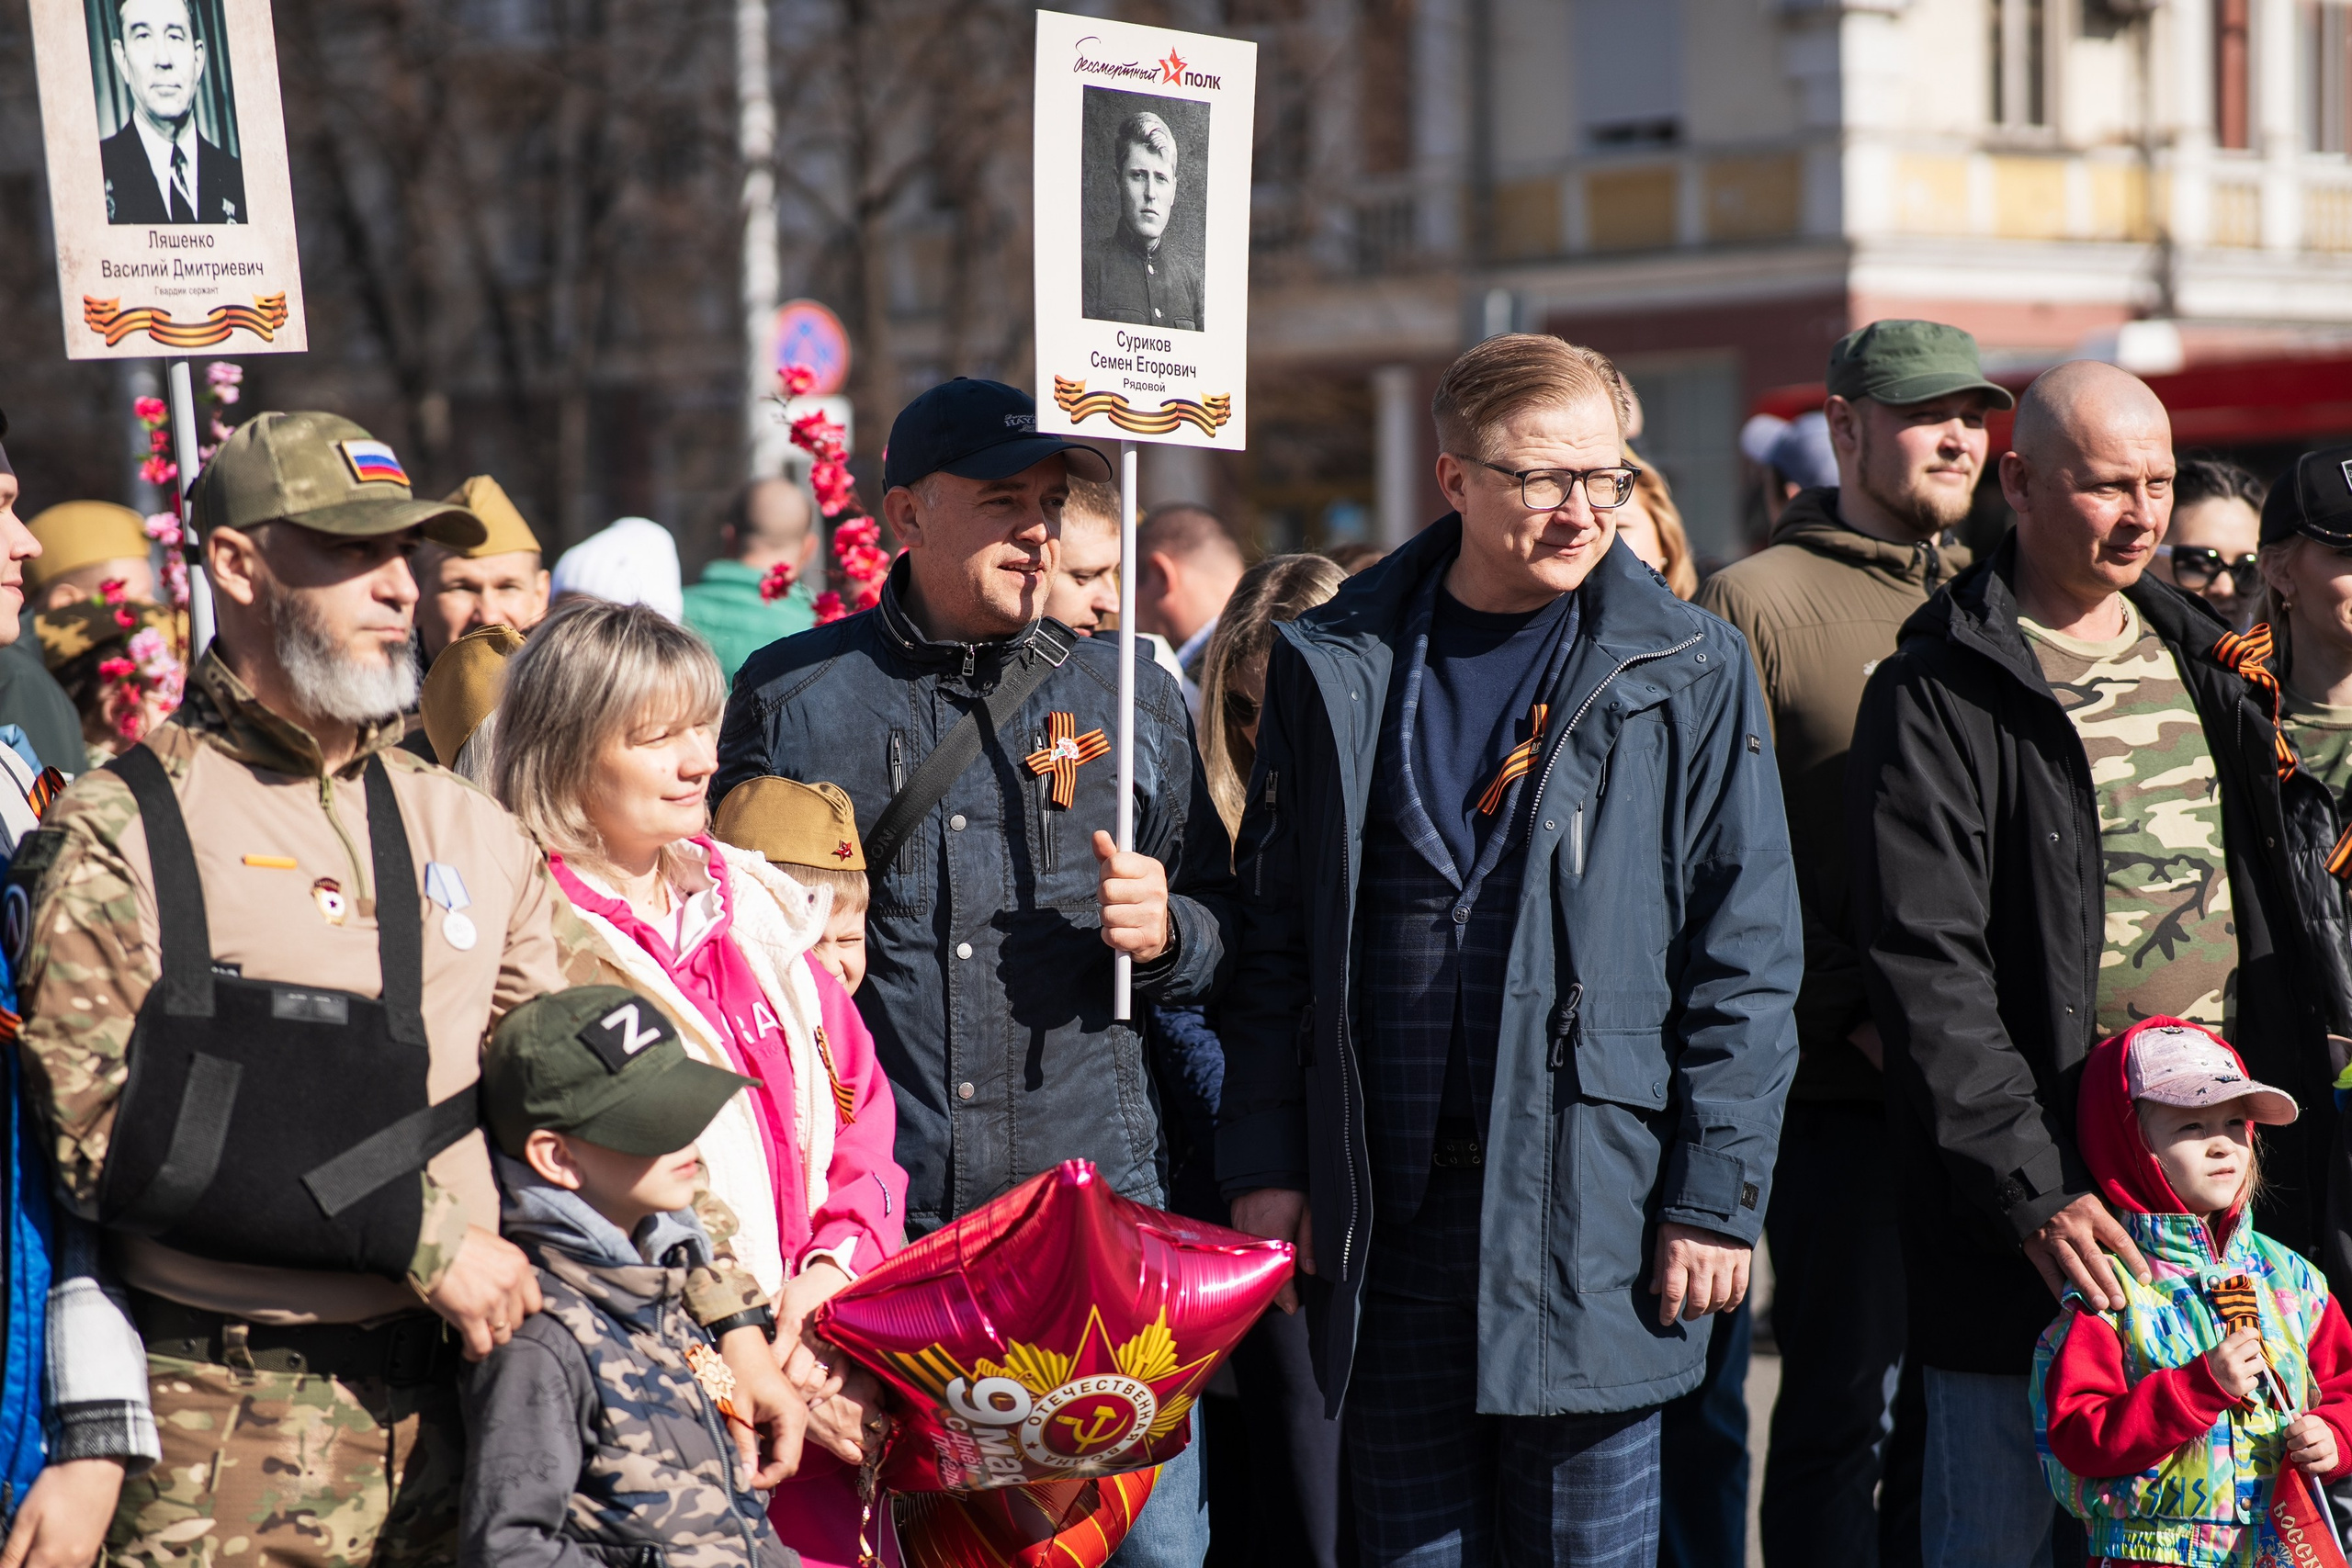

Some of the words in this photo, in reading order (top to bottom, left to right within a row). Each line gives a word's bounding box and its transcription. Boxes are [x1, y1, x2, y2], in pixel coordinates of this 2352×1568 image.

[149, 231, 215, 249] Ляшенко
[101, 259, 169, 278] Василий
[173, 258, 265, 281] Дмитриевич
[154, 286, 187, 296] Гвардии
[188, 286, 220, 296] сержант
[1116, 331, 1171, 353] Суриков
[1091, 351, 1133, 371] Семен
[1136, 355, 1197, 379] Егорович
[1123, 378, 1166, 393] Рядовой
[600, 1003, 662, 1055] Z
[945, 1376, 1032, 1425] 9
[1028, 1380, 1151, 1442] ОТЕЧЕСТВЕННАЯ
